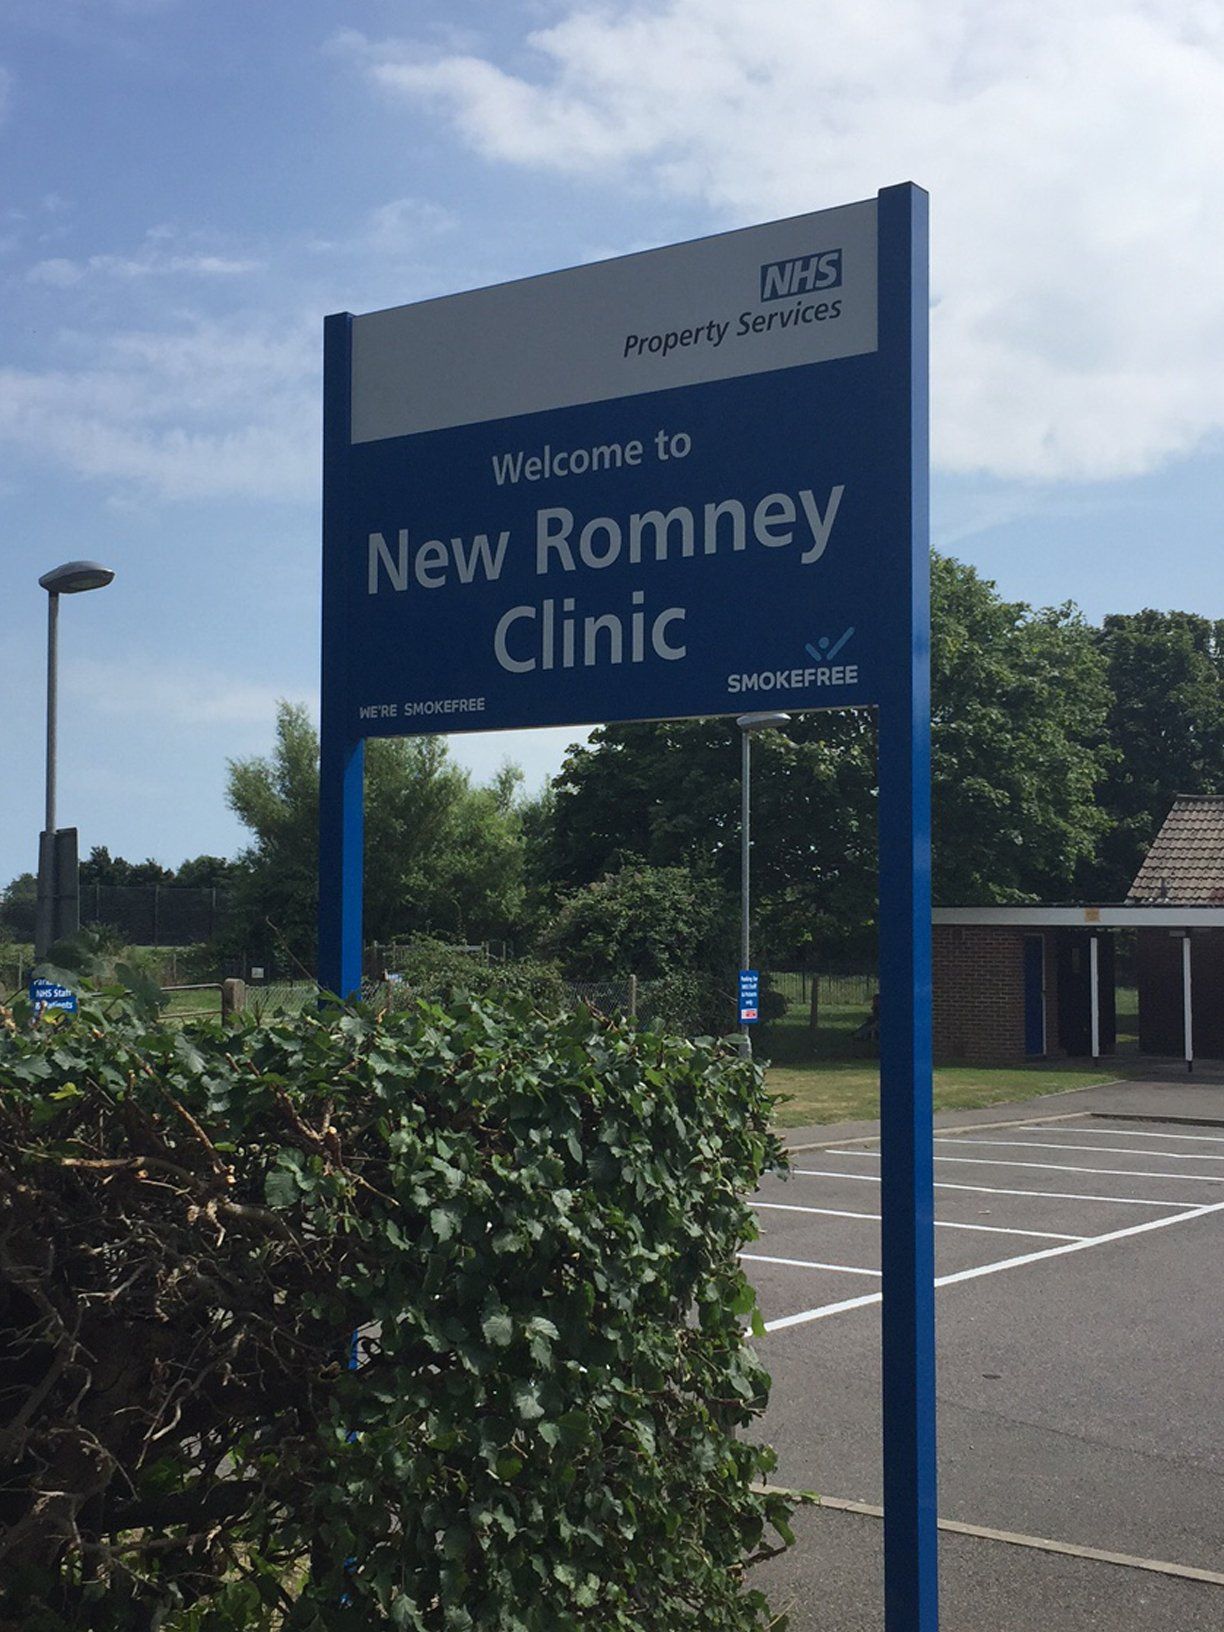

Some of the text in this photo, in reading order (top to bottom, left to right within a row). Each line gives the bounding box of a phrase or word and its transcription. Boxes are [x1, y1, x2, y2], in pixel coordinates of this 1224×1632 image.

[763, 253, 839, 299] NHS
[624, 300, 842, 358] Property Services
[491, 430, 692, 486] Welcome to
[368, 485, 845, 595] New Romney
[494, 590, 687, 673] Clinic
[727, 665, 859, 693] SMOKEFREE
[359, 697, 486, 719] WE'RE SMOKEFREE
